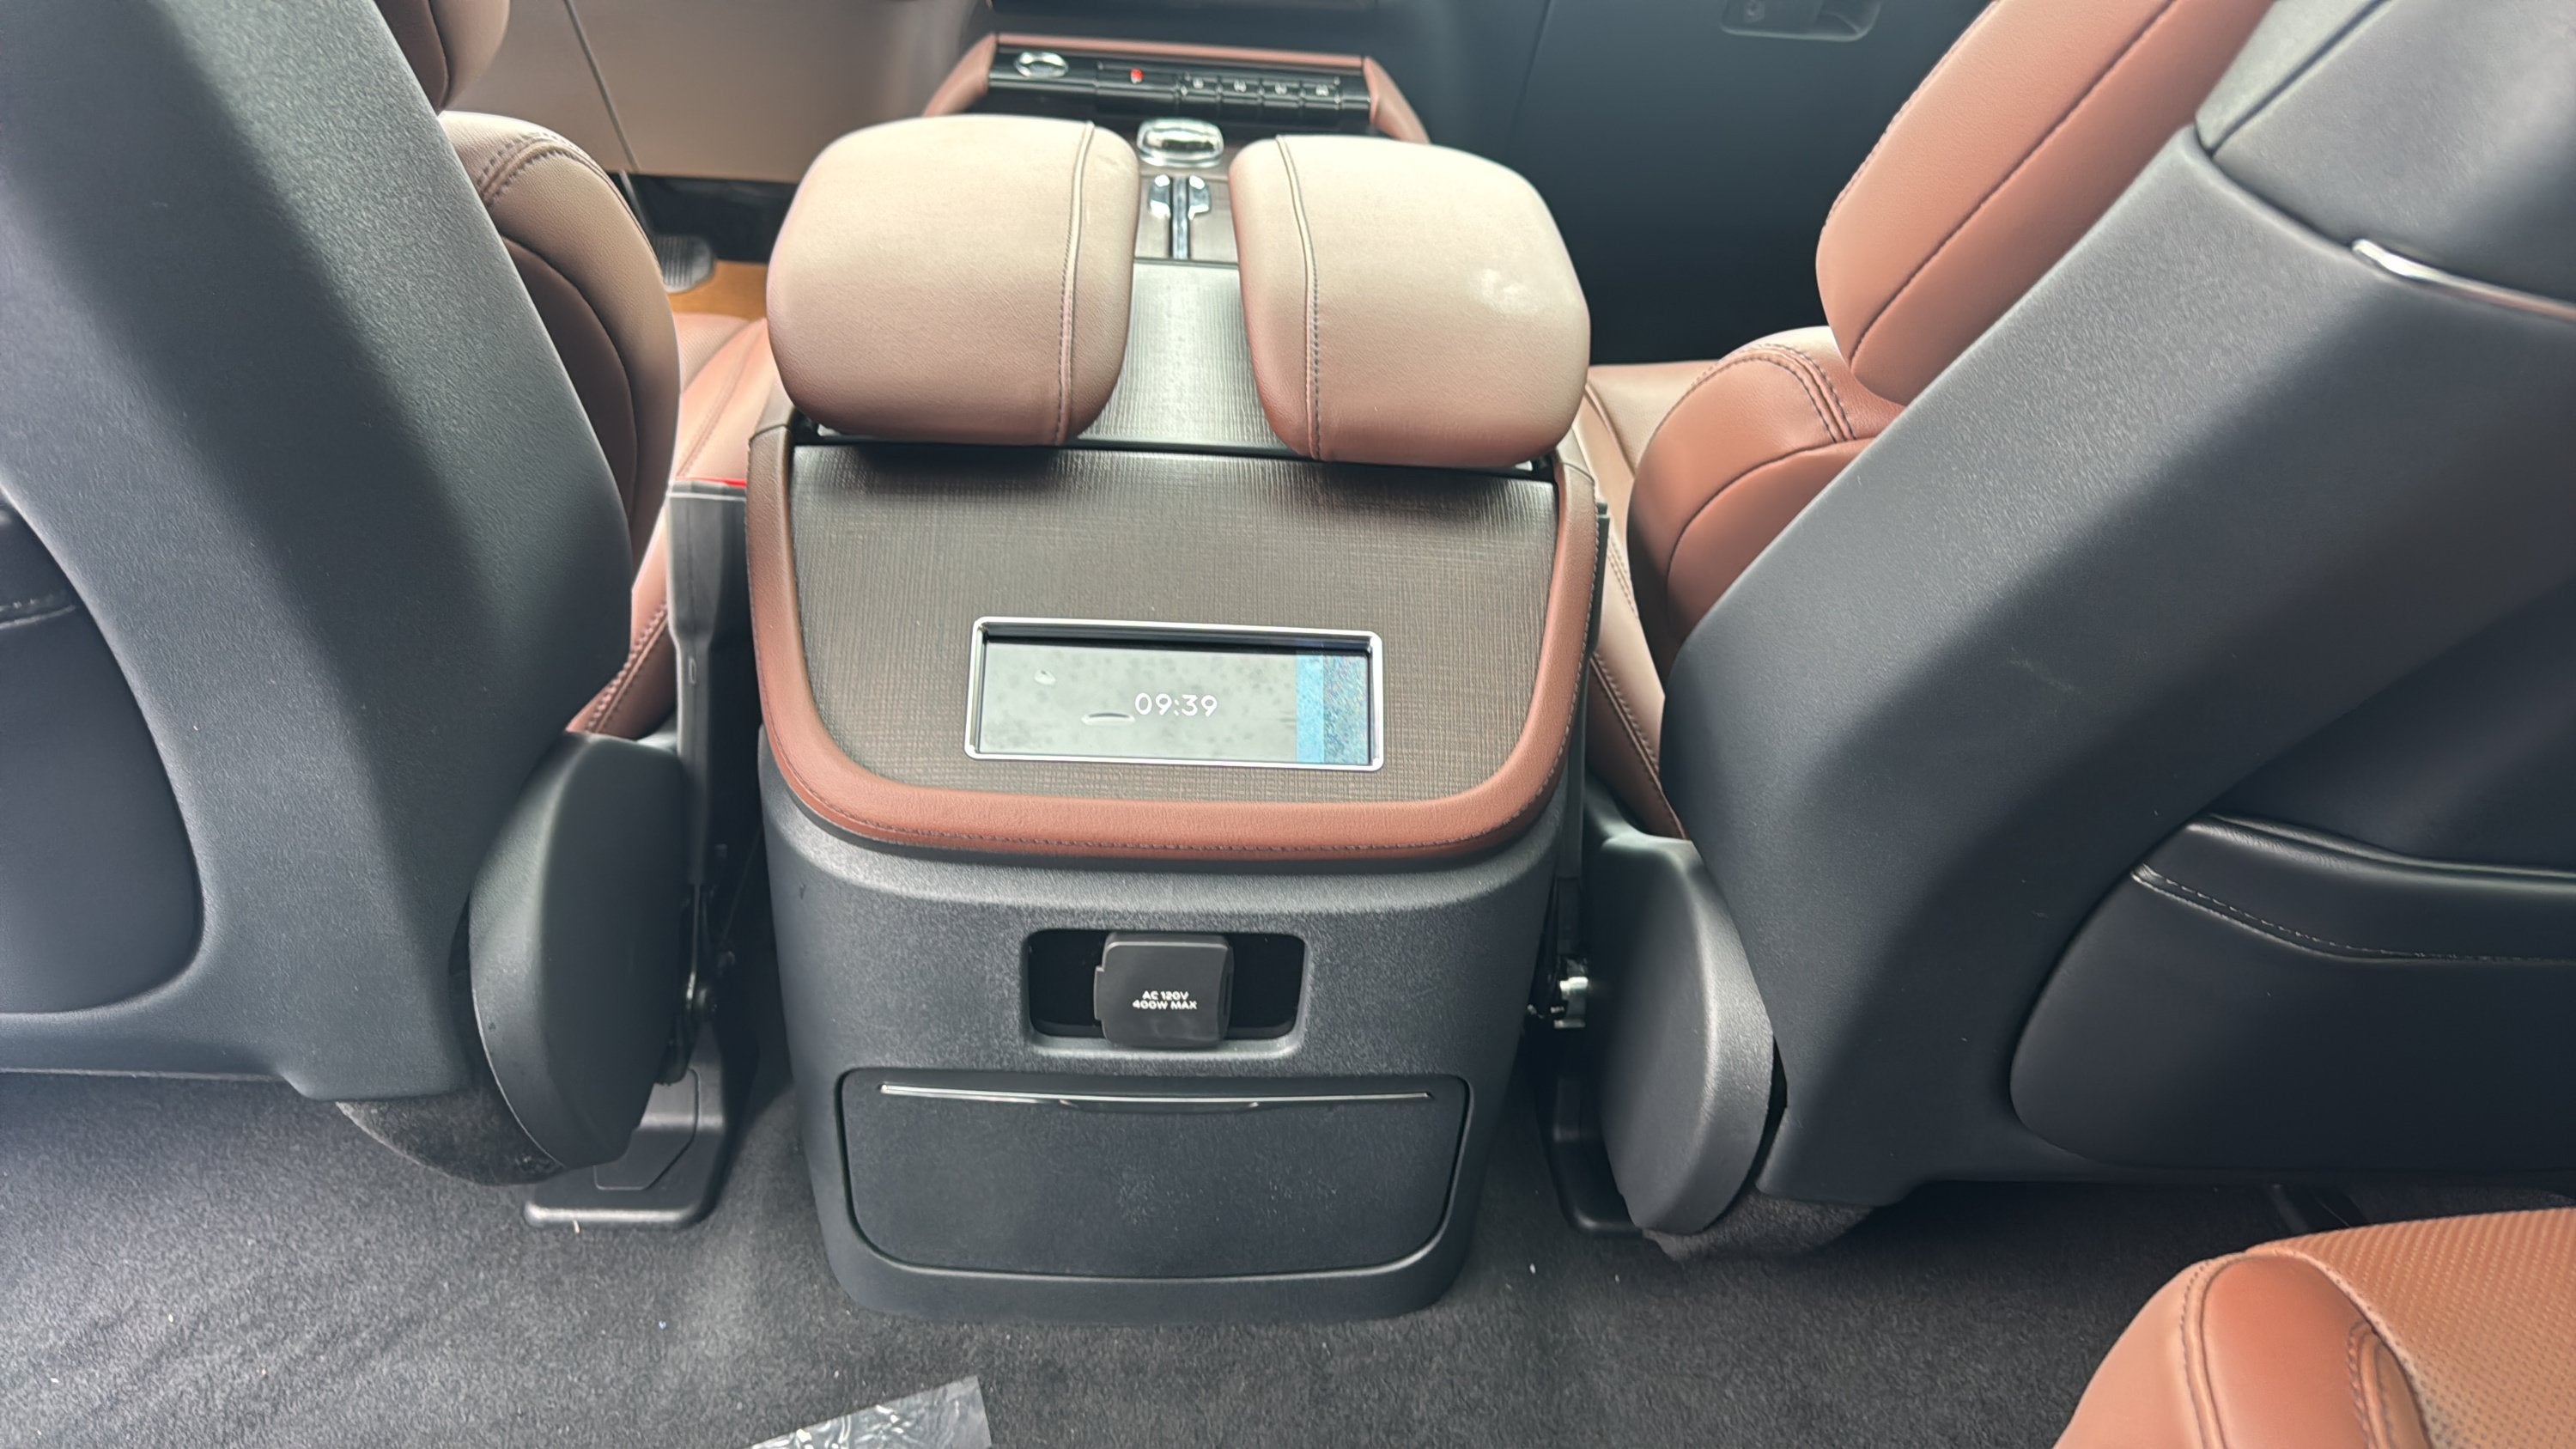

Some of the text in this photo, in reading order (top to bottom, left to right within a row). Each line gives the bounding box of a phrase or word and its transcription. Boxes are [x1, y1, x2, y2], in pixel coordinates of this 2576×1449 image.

[1134, 692, 1218, 717] 09:39
[1142, 990, 1189, 1001] AC 120V
[1133, 999, 1198, 1010] 400W MAX
